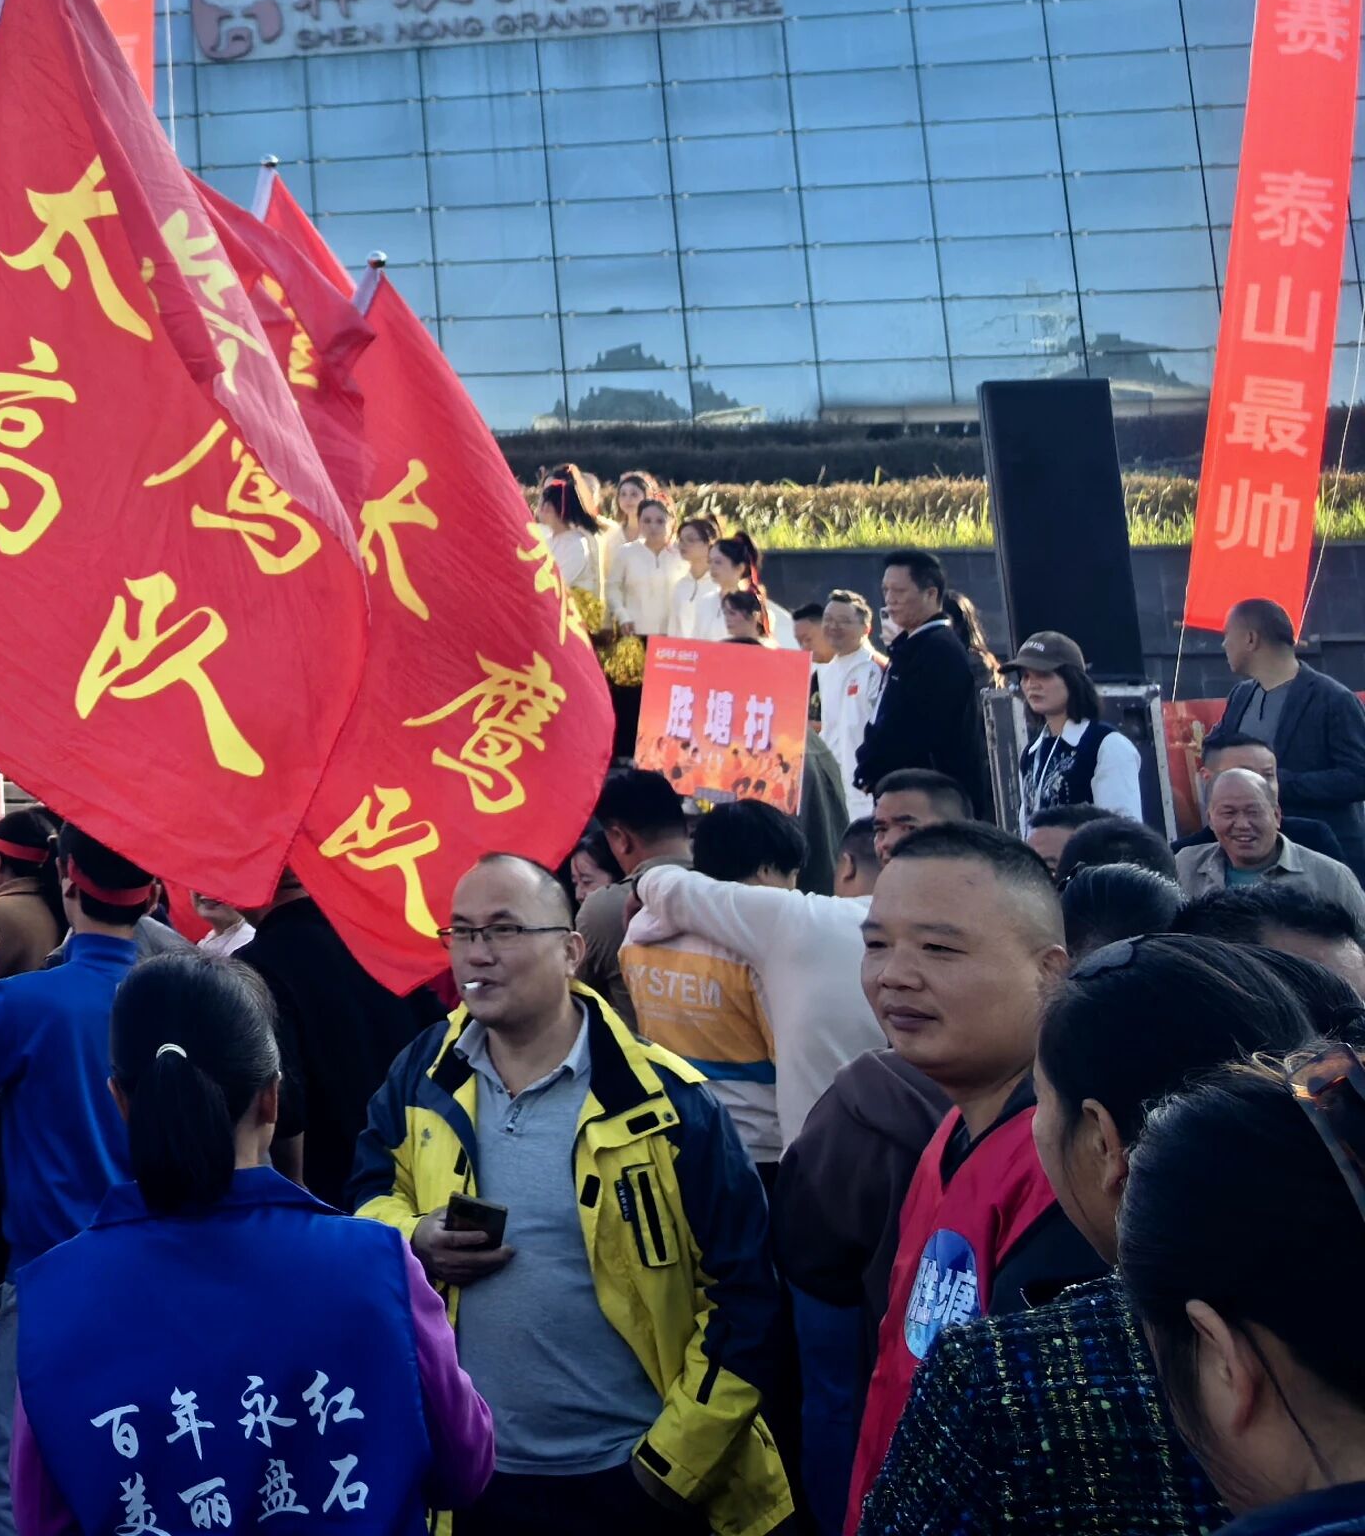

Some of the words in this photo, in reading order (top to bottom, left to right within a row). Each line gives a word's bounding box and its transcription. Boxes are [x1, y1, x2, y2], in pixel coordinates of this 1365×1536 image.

[296, 25, 383, 50] SHEN
[396, 16, 484, 42] NONG
[493, 6, 610, 36] GRAND
[1214, 167, 1336, 563] 泰山最帅
[665, 683, 775, 751] 胜塘村
[89, 1368, 365, 1462] 百年永红
[114, 1453, 370, 1536] 美丽盘石
